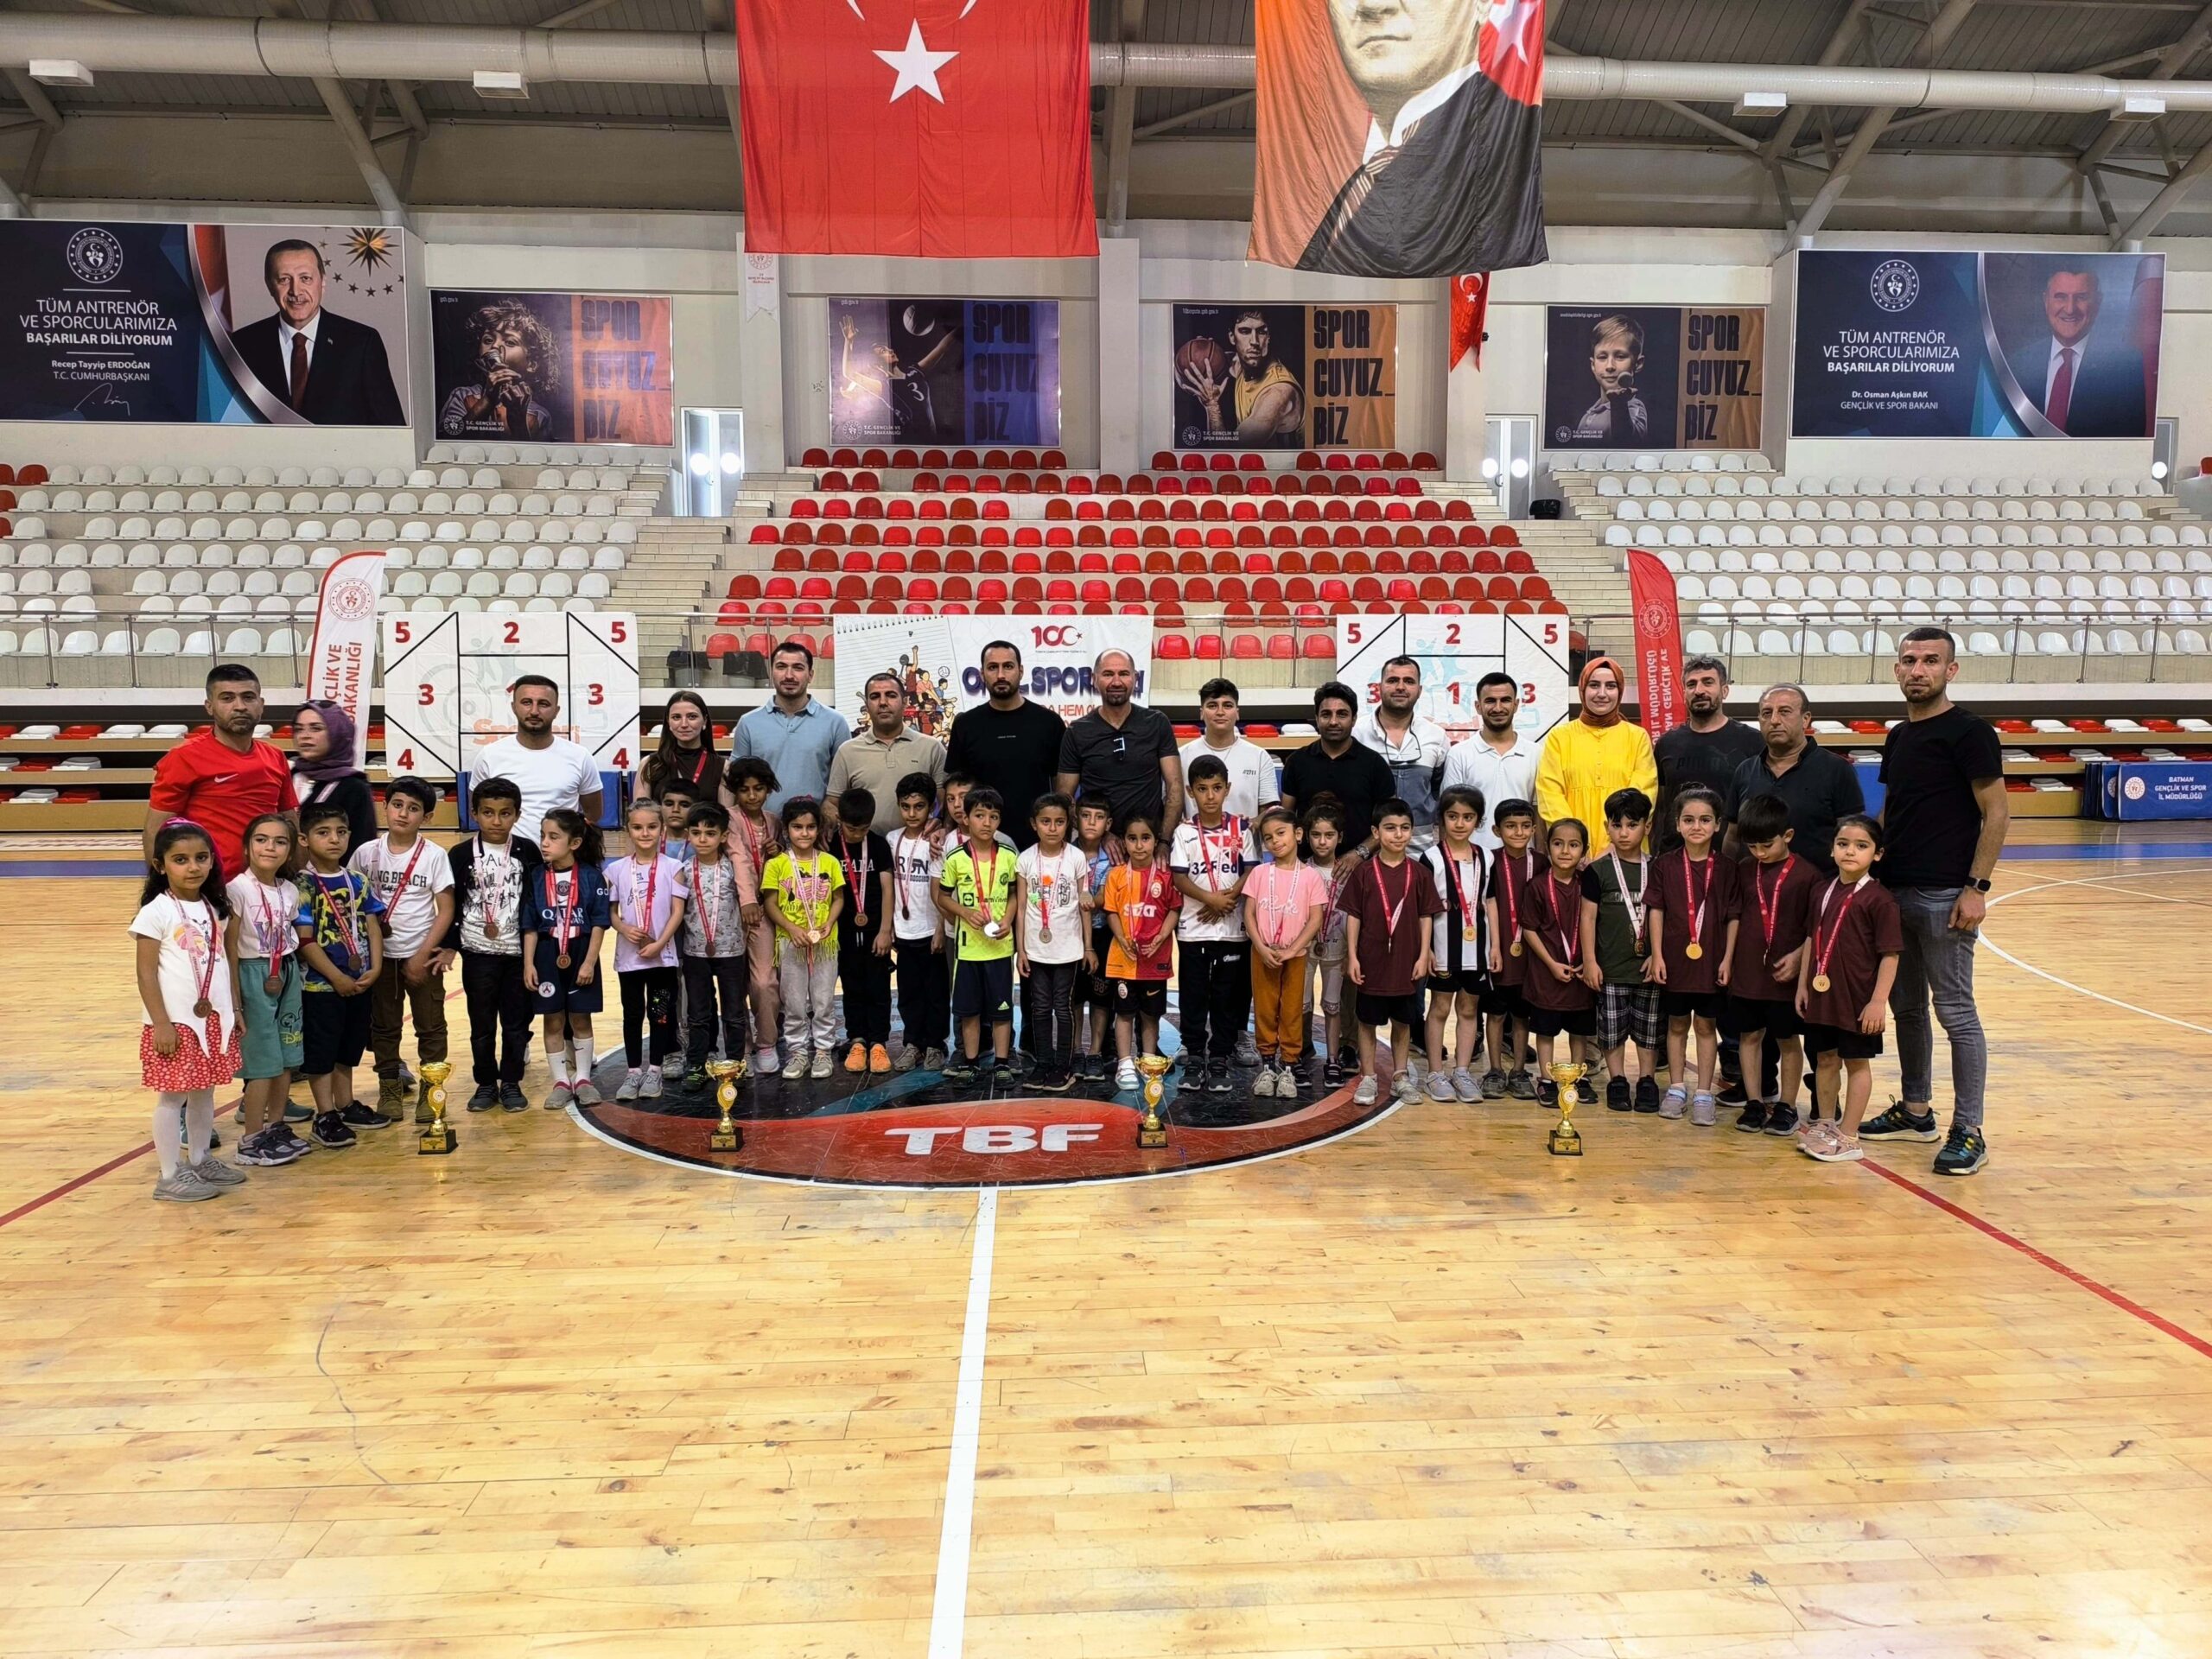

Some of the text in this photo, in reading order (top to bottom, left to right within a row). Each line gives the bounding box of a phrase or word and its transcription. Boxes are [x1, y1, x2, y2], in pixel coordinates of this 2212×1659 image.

[36, 298, 159, 315] TÜM ANTRENÖR
[20, 315, 178, 331] VE SPORCULARIMIZA
[582, 300, 640, 341] SPOR
[973, 303, 1030, 344] SPOR
[1313, 309, 1370, 348] SPOR
[26, 333, 173, 346] BAŞARILAR DİLİYORUM
[1688, 315, 1740, 351] SPOR
[1840, 330, 1946, 345] TÜM ANTRENÖR
[1823, 346, 1960, 359] VE SPORCULARIMIZA
[52, 359, 150, 370] Recep Tayyip ERDOĞAN
[1827, 361, 1955, 375] BAŞARILAR DİLİYORUM
[71, 372, 150, 382] CUMHURBAŞKANI
[1840, 401, 1873, 411] GENÇLİK
[1891, 391, 1910, 400] Aşkın
[1313, 403, 1348, 445] BİZ
[1686, 401, 1718, 440] BİZ
[395, 621, 410, 643] 5
[503, 621, 519, 643] 2
[611, 621, 626, 643] 5
[1347, 623, 1362, 644] 5
[1446, 623, 1461, 644] 2
[1543, 623, 1559, 644] 5
[327, 645, 342, 663] VE
[418, 683, 435, 705] 3
[588, 683, 604, 705] 3
[1367, 683, 1382, 703] 3
[1447, 683, 1459, 704] 1
[1521, 683, 1536, 703] 3
[1058, 705, 1084, 716] HEM
[397, 749, 414, 770] 4
[613, 748, 629, 769] 4
[885, 1123, 1103, 1154] TBF
